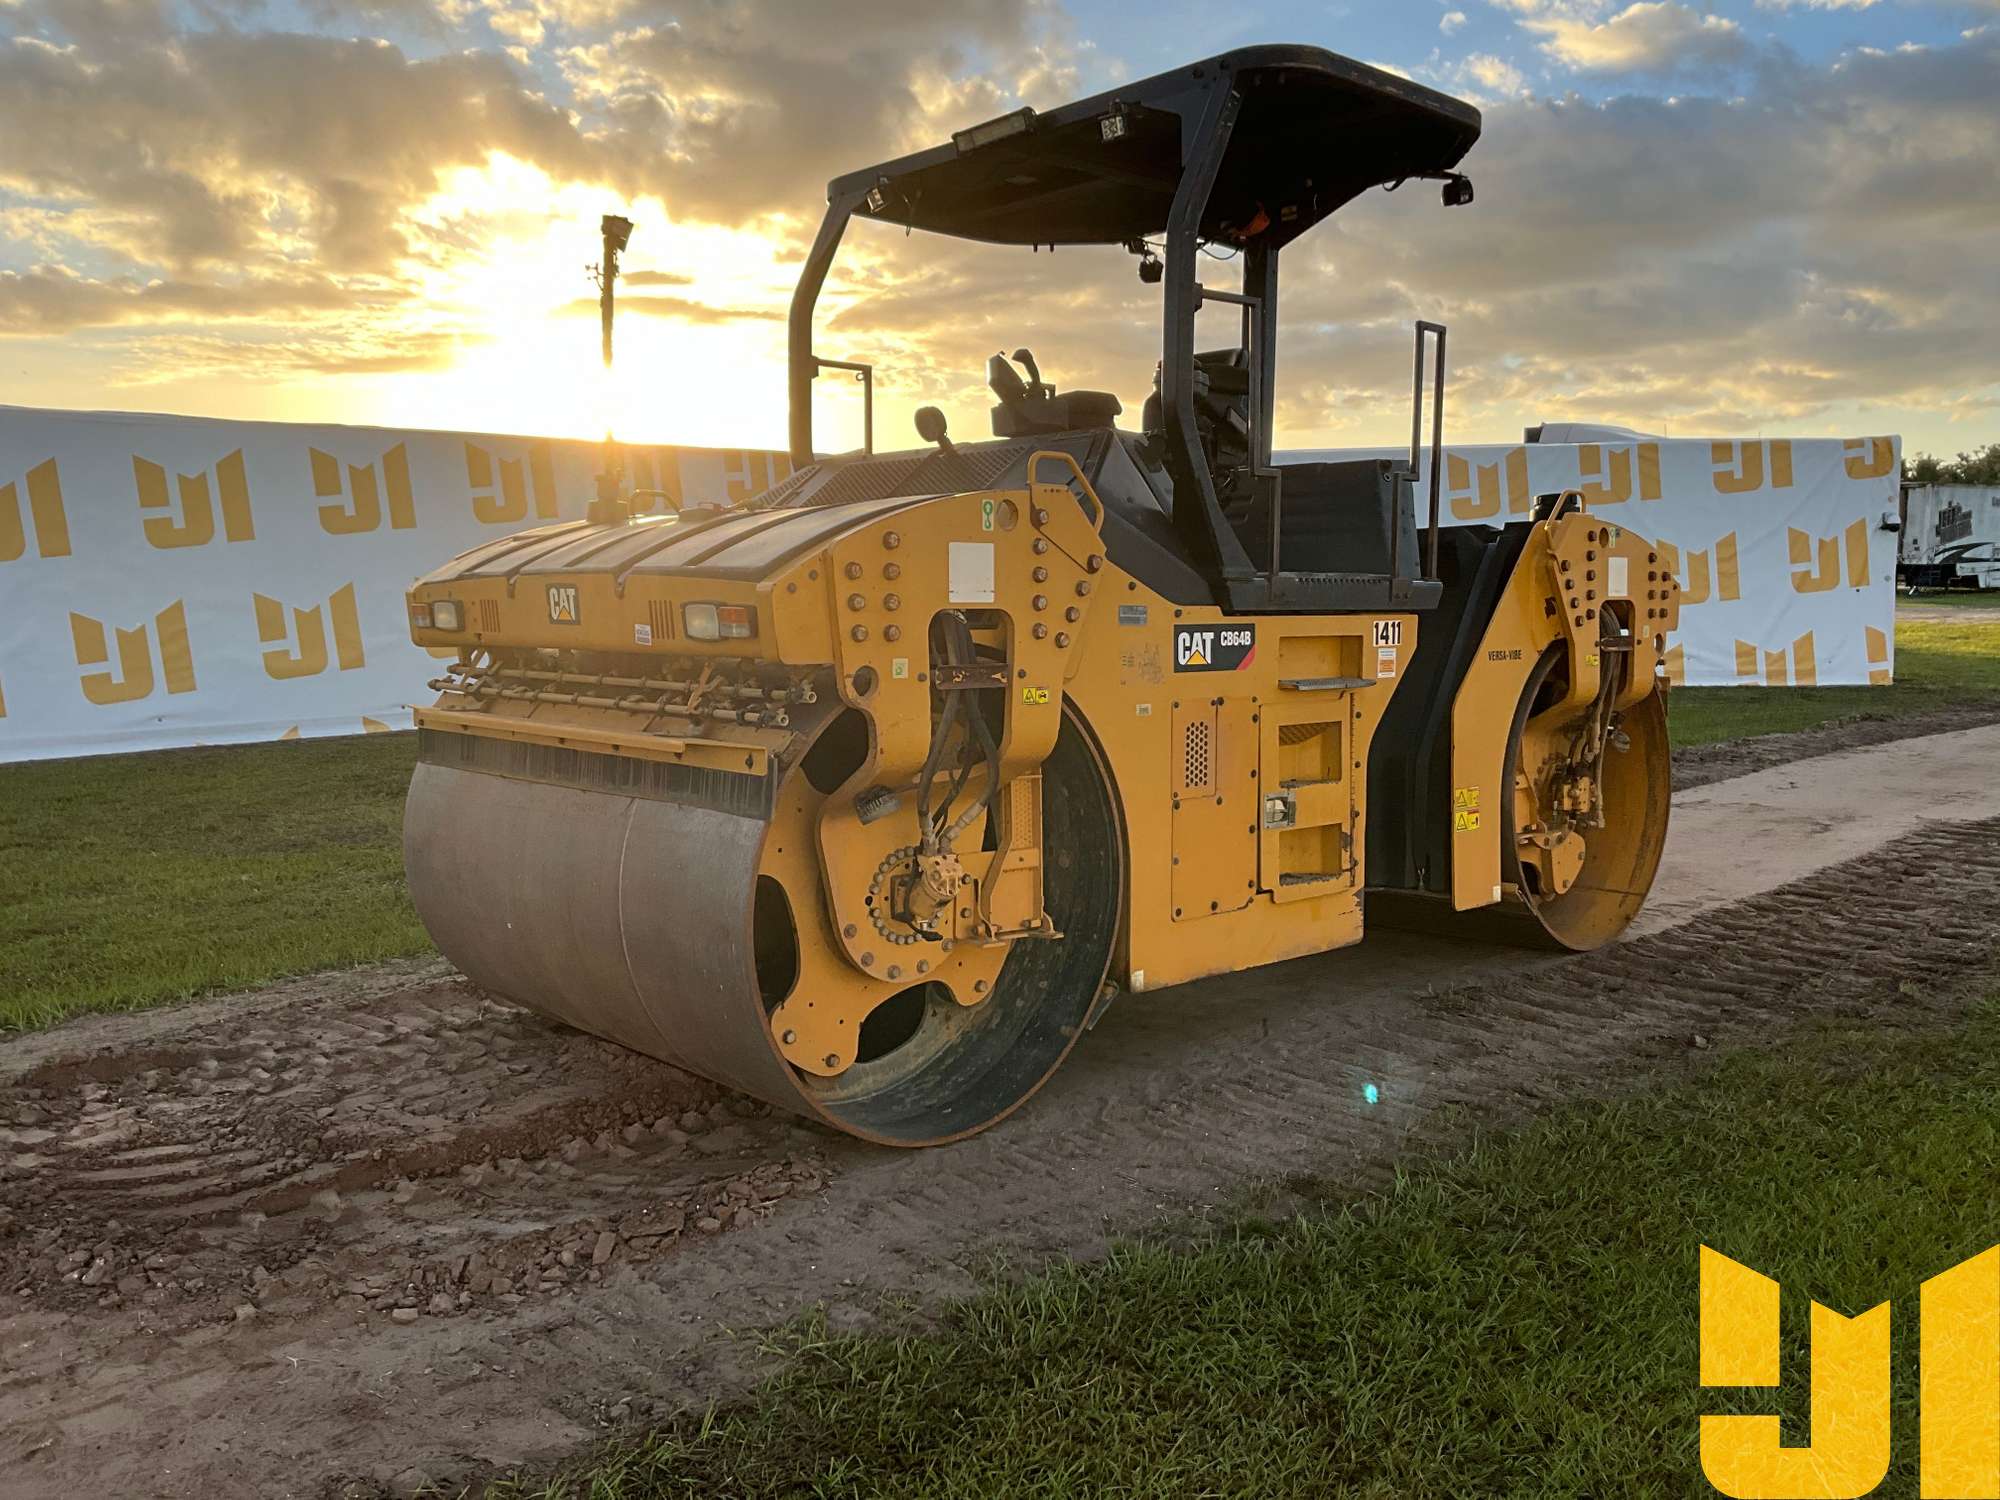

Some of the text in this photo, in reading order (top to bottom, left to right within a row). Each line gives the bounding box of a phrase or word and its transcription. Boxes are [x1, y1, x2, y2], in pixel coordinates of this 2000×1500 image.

[549, 587, 575, 621] CAT
[1220, 630, 1251, 647] CB64B
[1374, 621, 1401, 645] 1411
[1177, 631, 1214, 665] CAT
[1487, 649, 1522, 661] VERSA-VIBE
